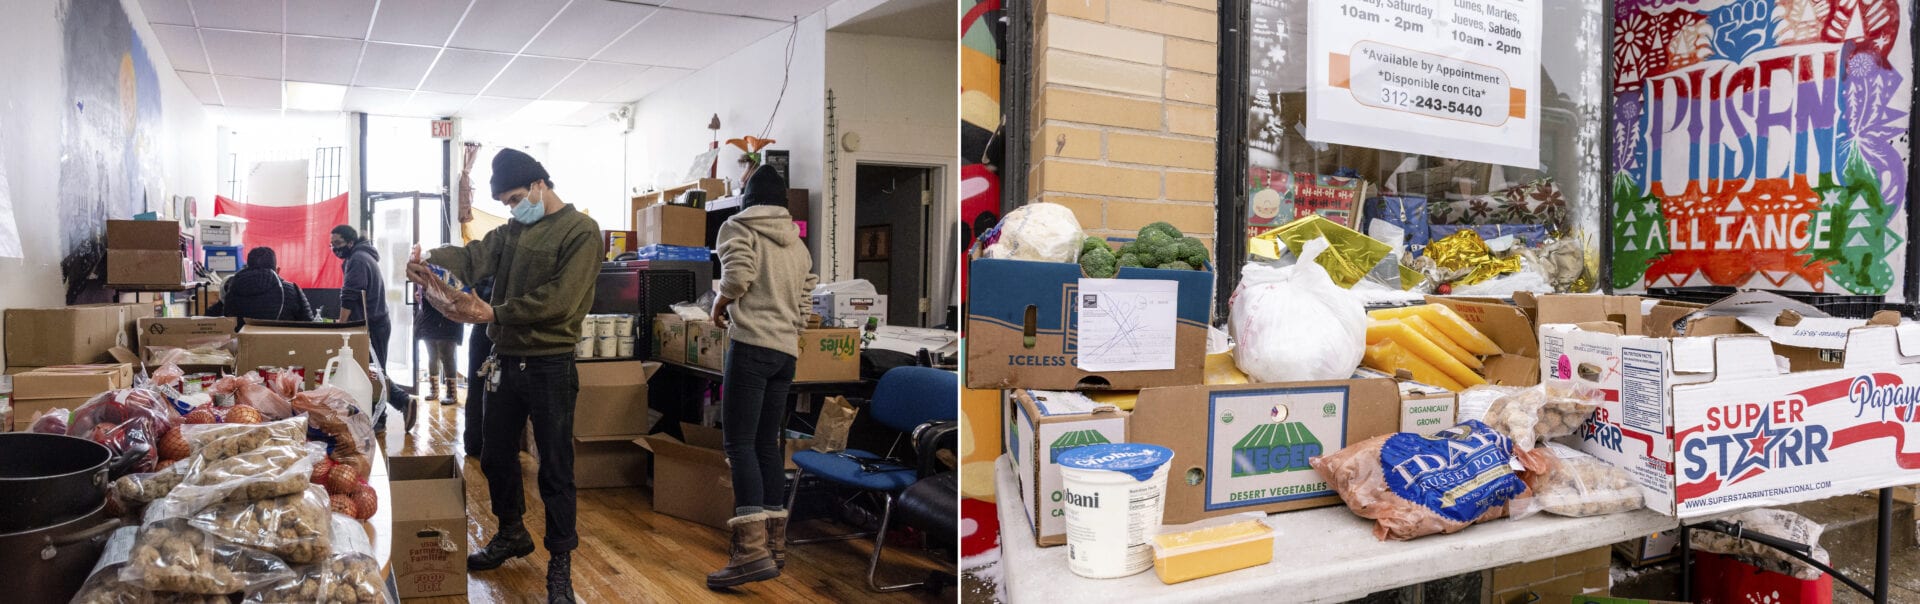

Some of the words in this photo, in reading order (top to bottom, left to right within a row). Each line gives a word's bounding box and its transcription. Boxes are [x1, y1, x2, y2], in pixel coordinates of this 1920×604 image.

[1340, 4, 1380, 23] 10am
[1394, 16, 1424, 33] 2pm
[1386, 0, 1433, 19] Saturday
[1454, 0, 1484, 16] Lunes,
[1486, 4, 1520, 24] Martes,
[1451, 13, 1487, 32] Jueves,
[1488, 21, 1522, 39] Sabado
[1451, 30, 1485, 47] 10am
[1496, 40, 1522, 55] 2pm
[1421, 60, 1434, 73] by
[1436, 64, 1500, 85] Appointment
[1442, 84, 1460, 95] con
[1381, 88, 1483, 117] 312-243-5440
[432, 121, 452, 137] EXIT
[1645, 211, 1832, 249] ALLIANCE
[1008, 355, 1065, 366] ICELESS
[1409, 405, 1449, 414] ORGANICALLY
[1706, 399, 1804, 431] SUPER
[1417, 418, 1440, 426] GROWN
[1230, 488, 1266, 501] DESERT
[1269, 482, 1327, 497] VEGETABLES
[1418, 468, 1470, 492] RUSSET
[1684, 481, 1832, 509] WWW.SUPERSTARRINTERNATIONAL.COM
[414, 574, 445, 584] FOOD
[418, 583, 441, 592] BOX
